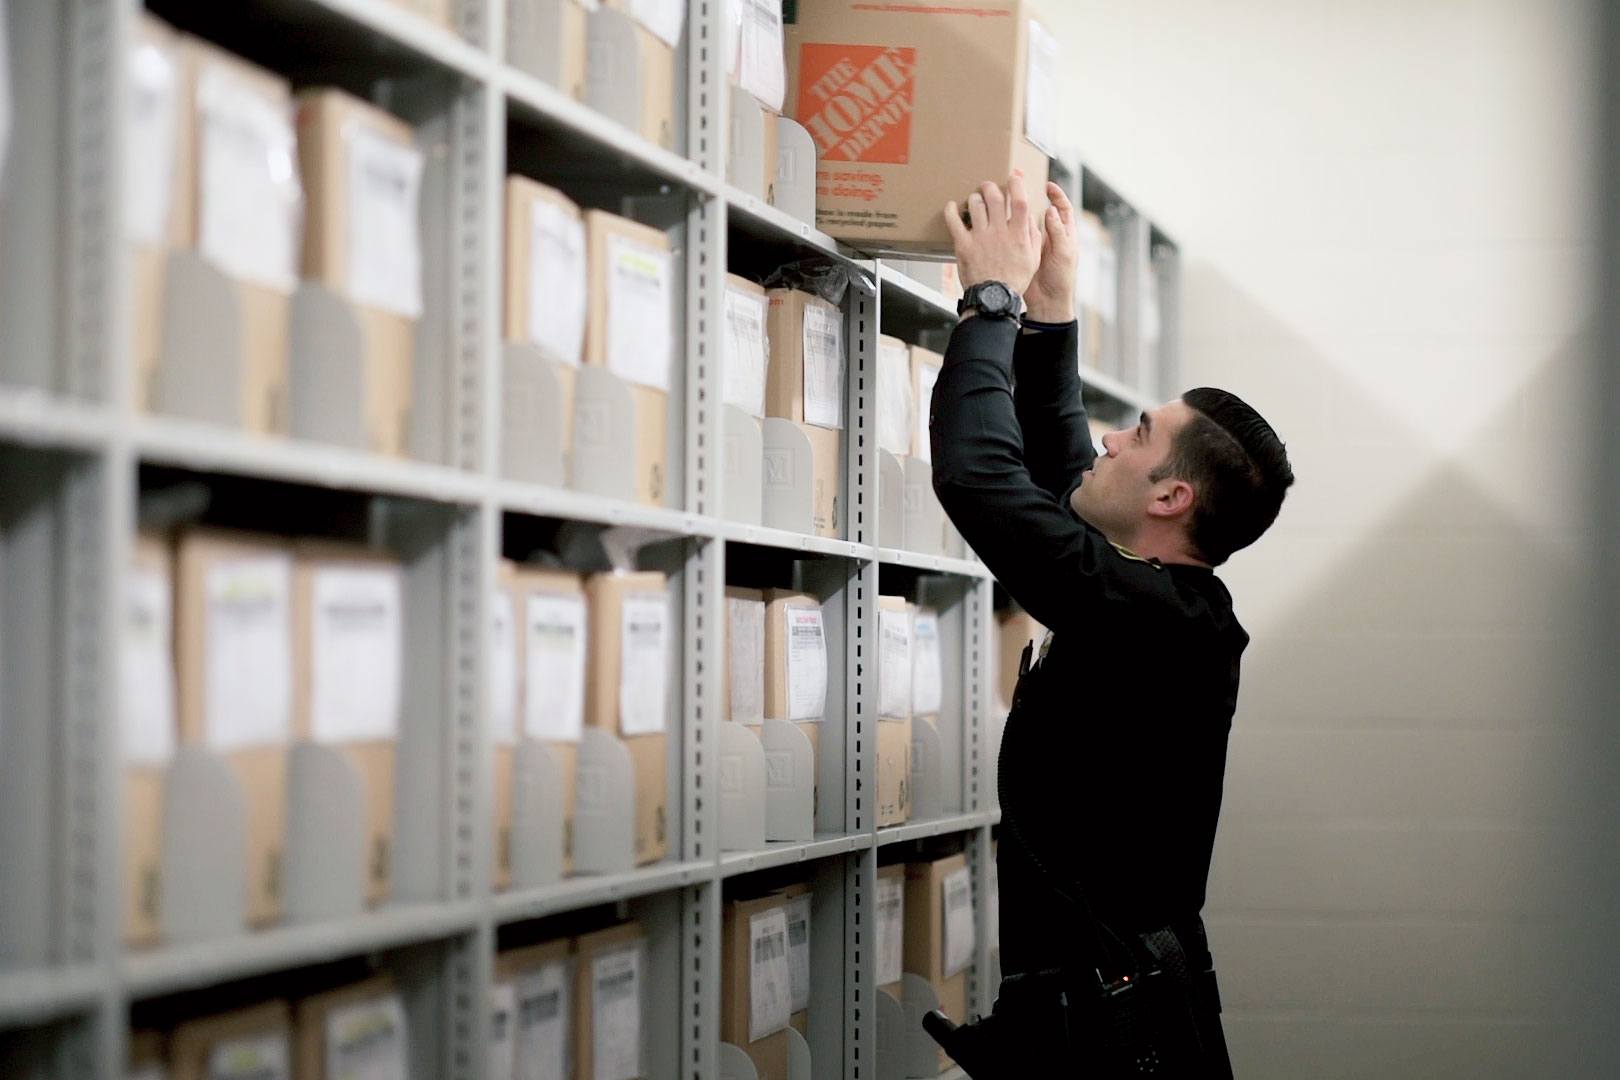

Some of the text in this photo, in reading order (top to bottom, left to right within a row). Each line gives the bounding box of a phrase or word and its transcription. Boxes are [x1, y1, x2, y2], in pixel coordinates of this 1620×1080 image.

[810, 57, 859, 100] THE
[840, 91, 914, 160] DEPOT
[816, 172, 829, 180] re
[816, 187, 829, 196] re
